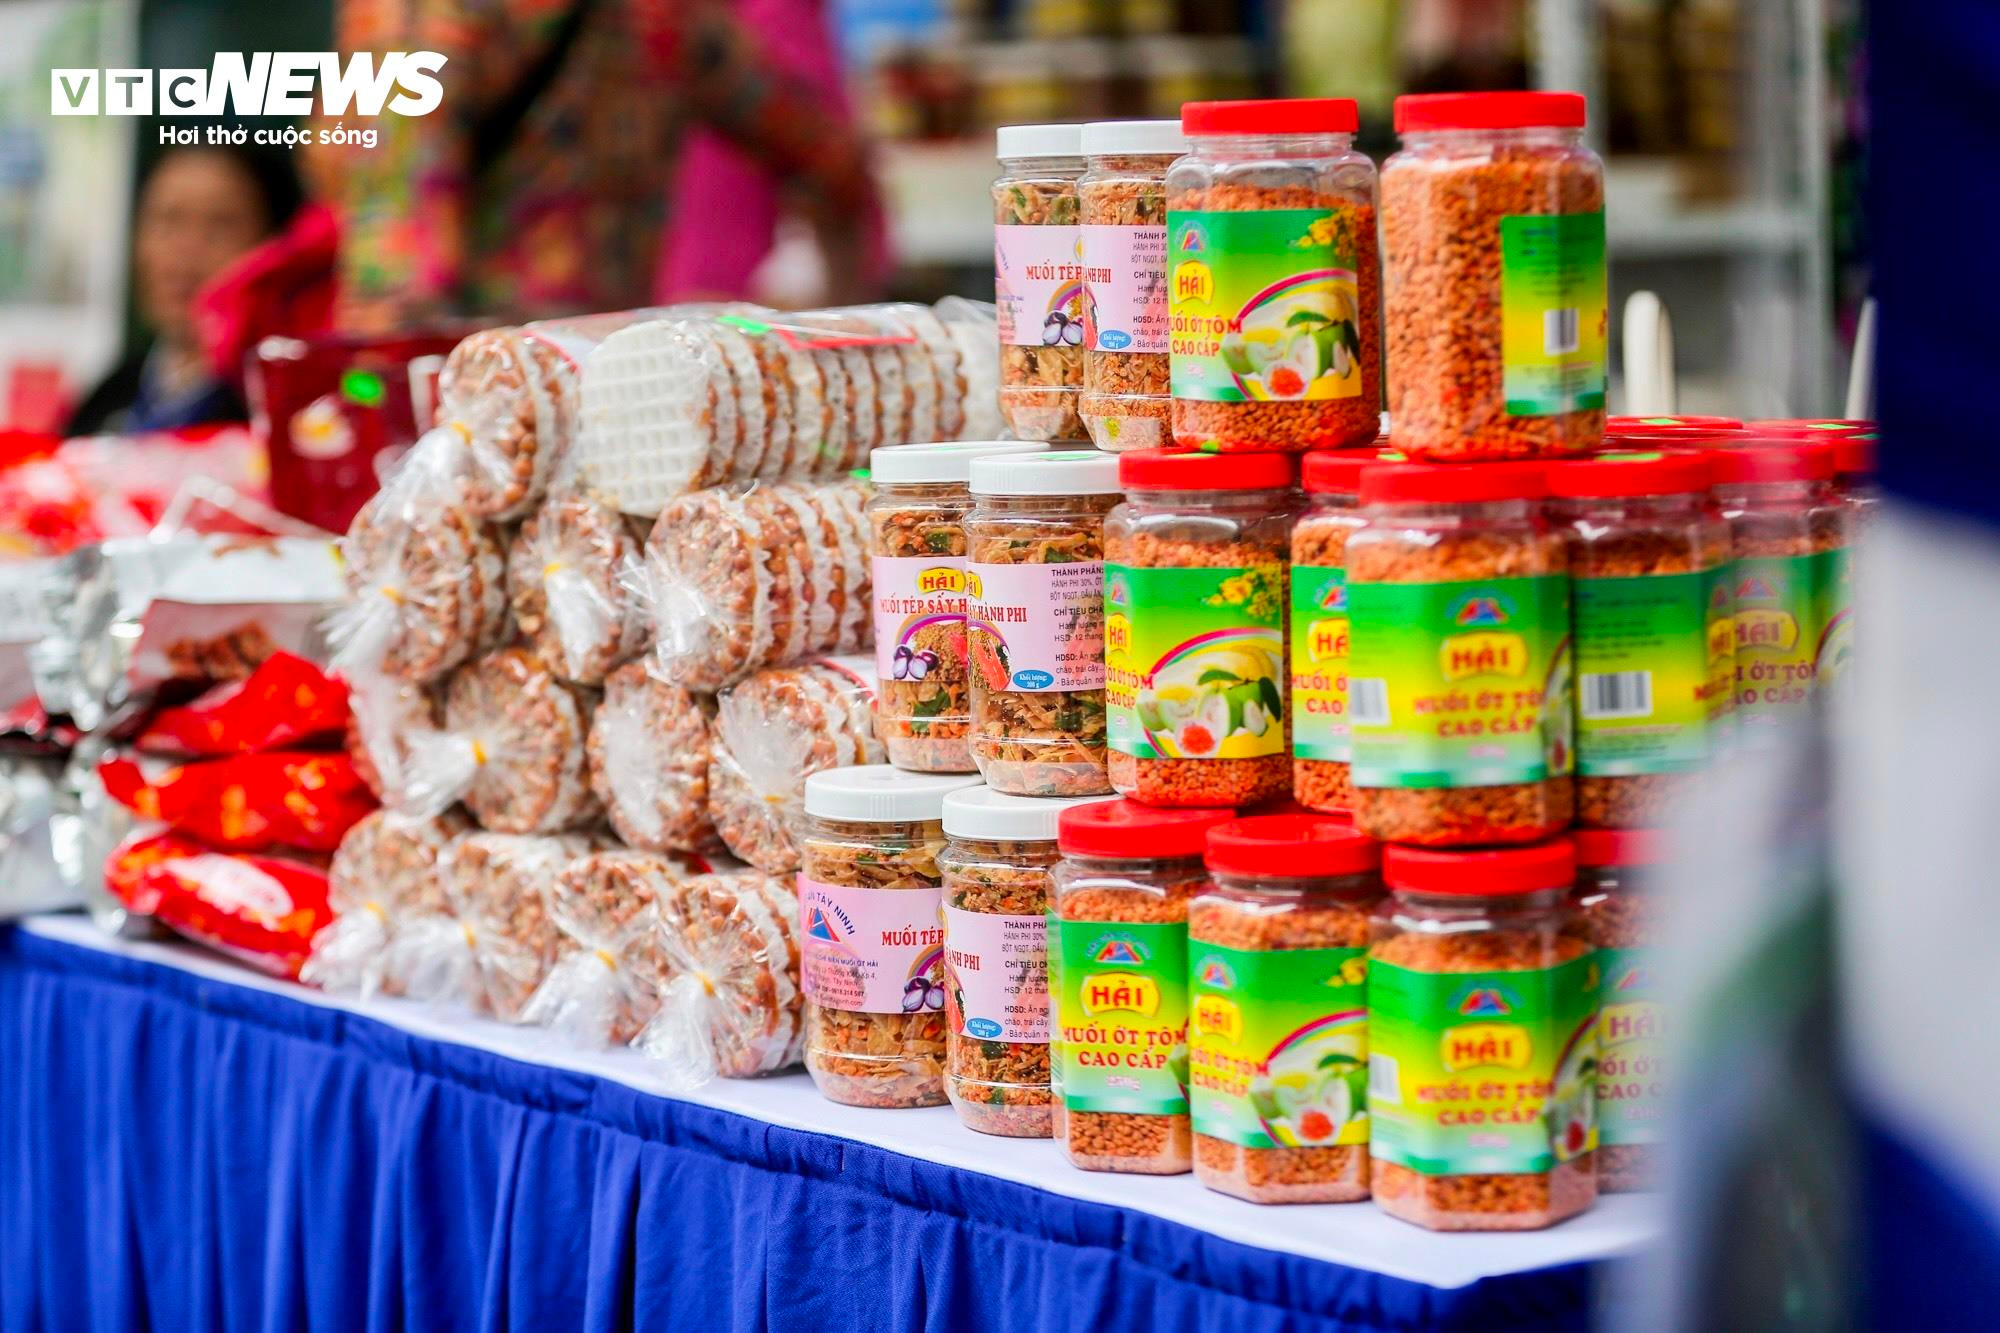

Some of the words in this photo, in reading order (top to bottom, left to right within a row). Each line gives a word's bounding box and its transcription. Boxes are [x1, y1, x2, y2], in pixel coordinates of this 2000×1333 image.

[1026, 258, 1055, 280] MUỐI
[1097, 268, 1111, 283] PHI
[1179, 269, 1204, 296] HẢI
[1206, 314, 1242, 335] TÔM
[1172, 339, 1195, 356] CAO
[922, 572, 955, 590] HẢI
[1051, 567, 1079, 577] THÀNH
[902, 595, 924, 614] TÉP
[927, 591, 954, 614] SẤY
[978, 601, 1004, 623] HÀNH
[1007, 607, 1027, 622] PHI
[1109, 620, 1127, 647] HẢI
[1316, 627, 1347, 656] HẢ
[1452, 641, 1509, 672] HẢI
[1106, 688, 1121, 706] CAO
[1306, 698, 1343, 715] CAO
[1437, 719, 1483, 737] CAO
[817, 892, 833, 907] TÂY
[834, 905, 855, 935] NINH
[882, 924, 917, 946] MUỐI
[920, 925, 944, 946] TÉP
[1003, 920, 1031, 929] THÀNH
[964, 955, 980, 971] PHI
[1091, 980, 1142, 1007] HẢI
[1114, 1025, 1139, 1045] ỚT
[1078, 1051, 1120, 1067] CAO
[1126, 1045, 1167, 1069] CẤP
[1453, 1032, 1511, 1062] HẢI
[1437, 1108, 1486, 1127] CAO
